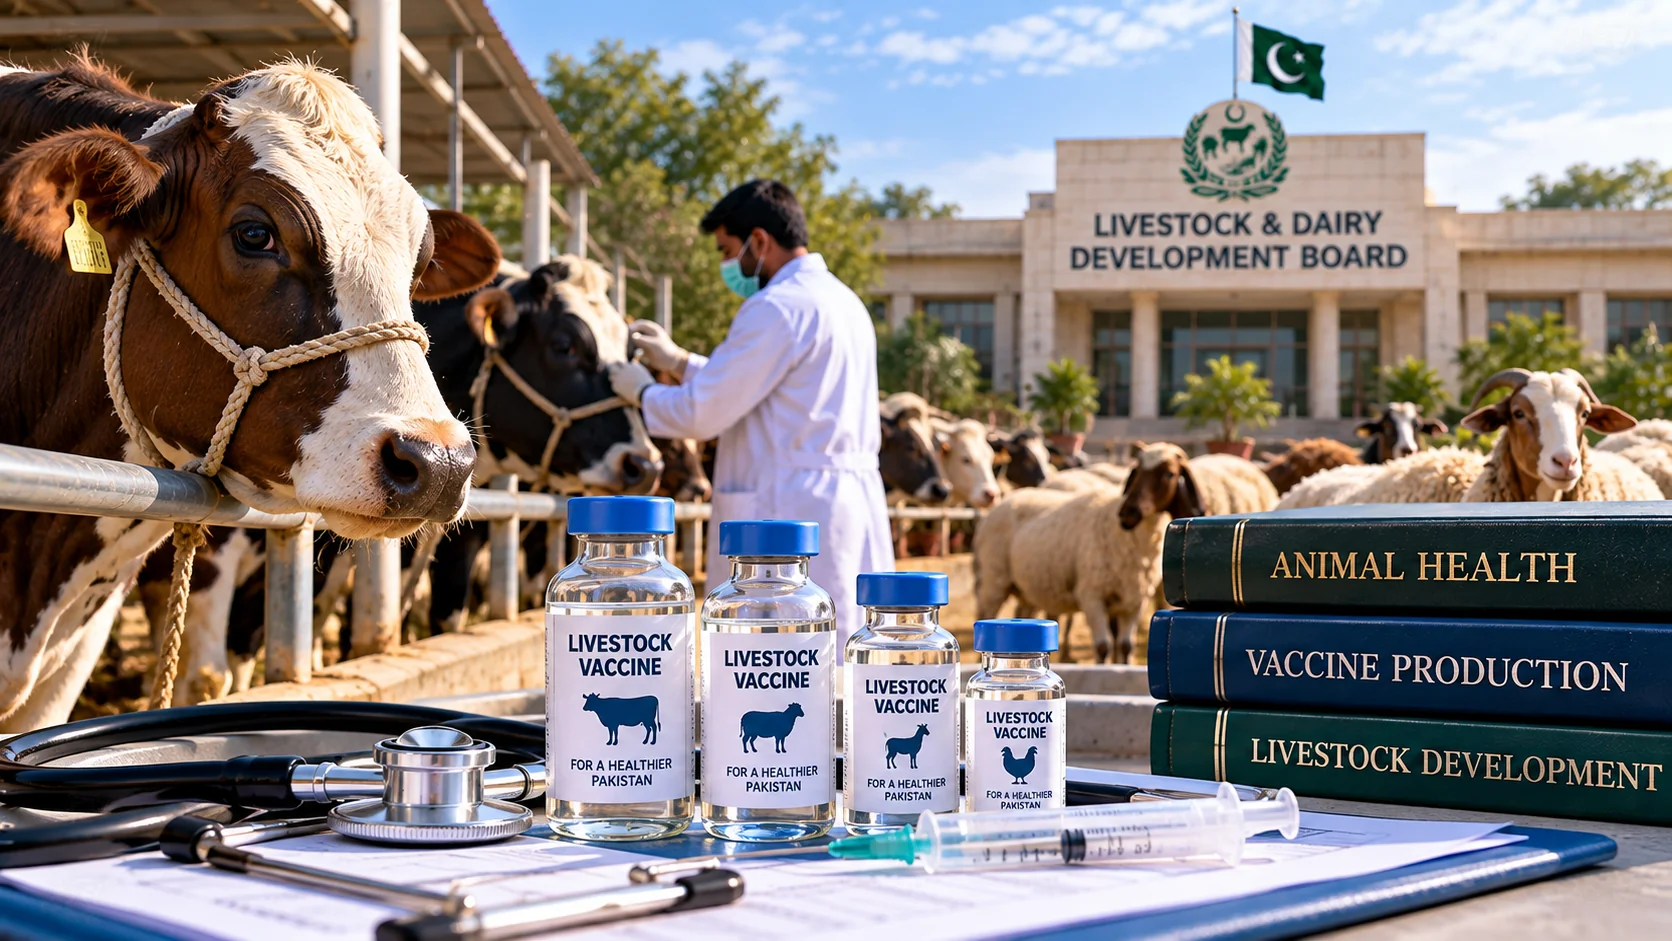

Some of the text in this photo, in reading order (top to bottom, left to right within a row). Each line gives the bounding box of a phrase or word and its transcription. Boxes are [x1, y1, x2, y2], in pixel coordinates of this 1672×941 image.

[1095, 211, 1383, 237] LIVESTOCK & DAIRY
[1070, 245, 1407, 270] DEVELOPMENT BOARD
[1270, 551, 1577, 583] ANIMAL HEALTH
[569, 634, 672, 652] LIVESTOCK
[725, 650, 819, 666] LIVESTOCK
[579, 658, 662, 677] VACCINE
[1246, 649, 1628, 693] VACCINE PRODUCTION
[734, 672, 810, 689] VACCINE
[866, 679, 947, 694] LIVESTOCK
[874, 699, 939, 714] VACCINE
[987, 711, 1052, 724] LIVESTOCK
[994, 727, 1046, 739] VACCINE
[571, 758, 672, 771] FOR A HEALTHIER
[727, 765, 818, 777] FOR A HEALTHIER
[1251, 738, 1663, 792] LIVESTOCK DEVELOPMENT
[592, 774, 652, 786] PAKISTAN
[746, 781, 801, 792] PAKISTAN
[868, 778, 946, 788] FOR A HEALTHIER
[885, 791, 931, 801] PAKISTAN
[987, 790, 1052, 799] FOR A HEALTHIER
